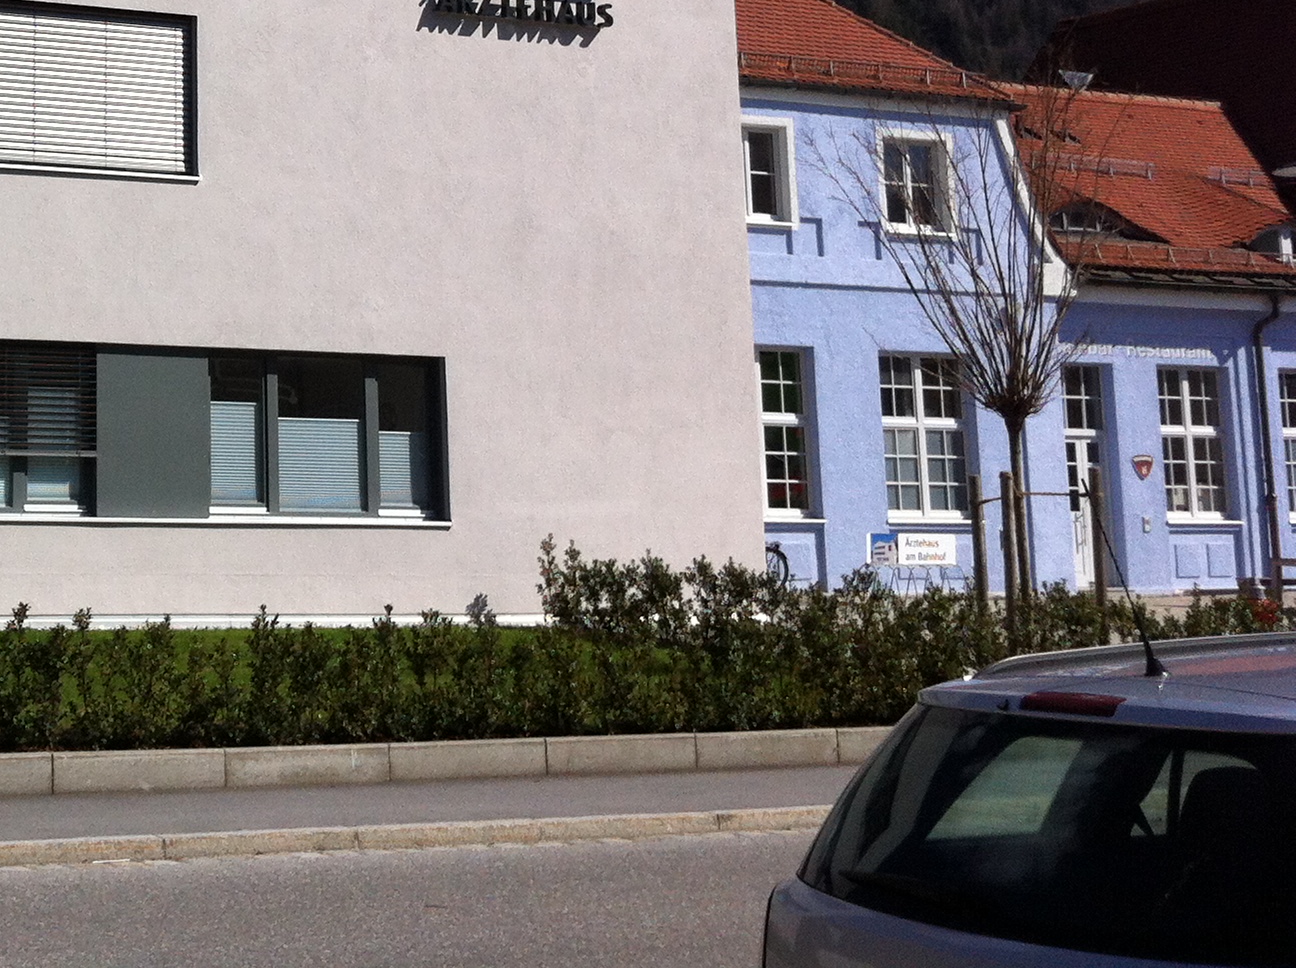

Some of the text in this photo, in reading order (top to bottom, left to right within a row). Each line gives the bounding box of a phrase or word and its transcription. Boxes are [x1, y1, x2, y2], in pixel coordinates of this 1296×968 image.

[905, 537, 939, 548] Ärztehaus
[905, 552, 946, 562] am Bahnhof
